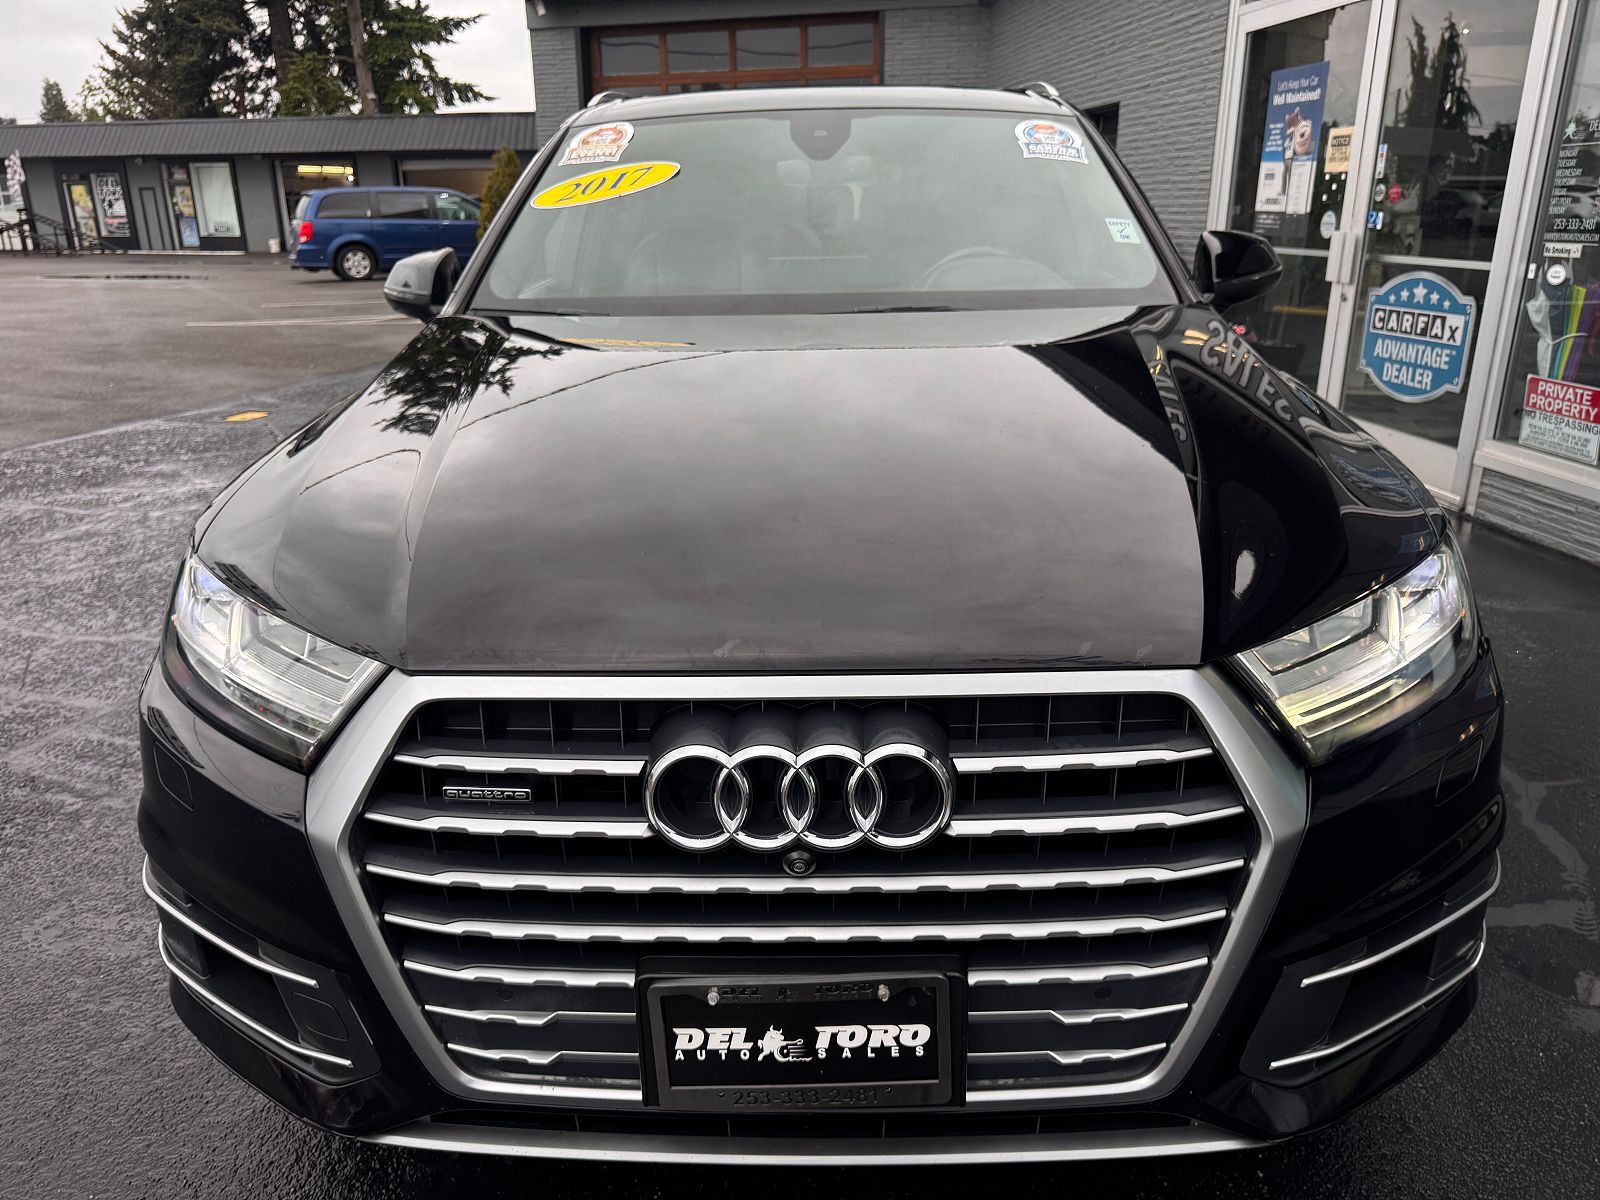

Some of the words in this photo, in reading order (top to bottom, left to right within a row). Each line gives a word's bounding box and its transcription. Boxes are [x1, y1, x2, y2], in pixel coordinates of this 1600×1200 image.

[1310, 75, 1320, 87] Car
[1331, 137, 1350, 146] NOTICE
[1556, 168, 1583, 177] WEDNESDAY
[1557, 159, 1577, 168] TUESDAY
[554, 166, 654, 204] 2017
[1548, 206, 1566, 214] SUNDAY
[1552, 246, 1571, 256] Smoking
[1374, 310, 1460, 343] CARFAX
[1373, 338, 1451, 370] ADVANTAGE
[1382, 361, 1433, 391] DEALER
[1537, 381, 1593, 405] PRIVATE
[1529, 393, 1598, 421] PROPERTY
[1539, 412, 1599, 435] TRESPASSING
[446, 789, 527, 799] quattro
[672, 1027, 754, 1051] DEL
[814, 1023, 931, 1049] TORO
[675, 1049, 750, 1062] AUTO
[818, 1045, 924, 1060] SALES
[733, 1088, 878, 1106] 253-333-2481
